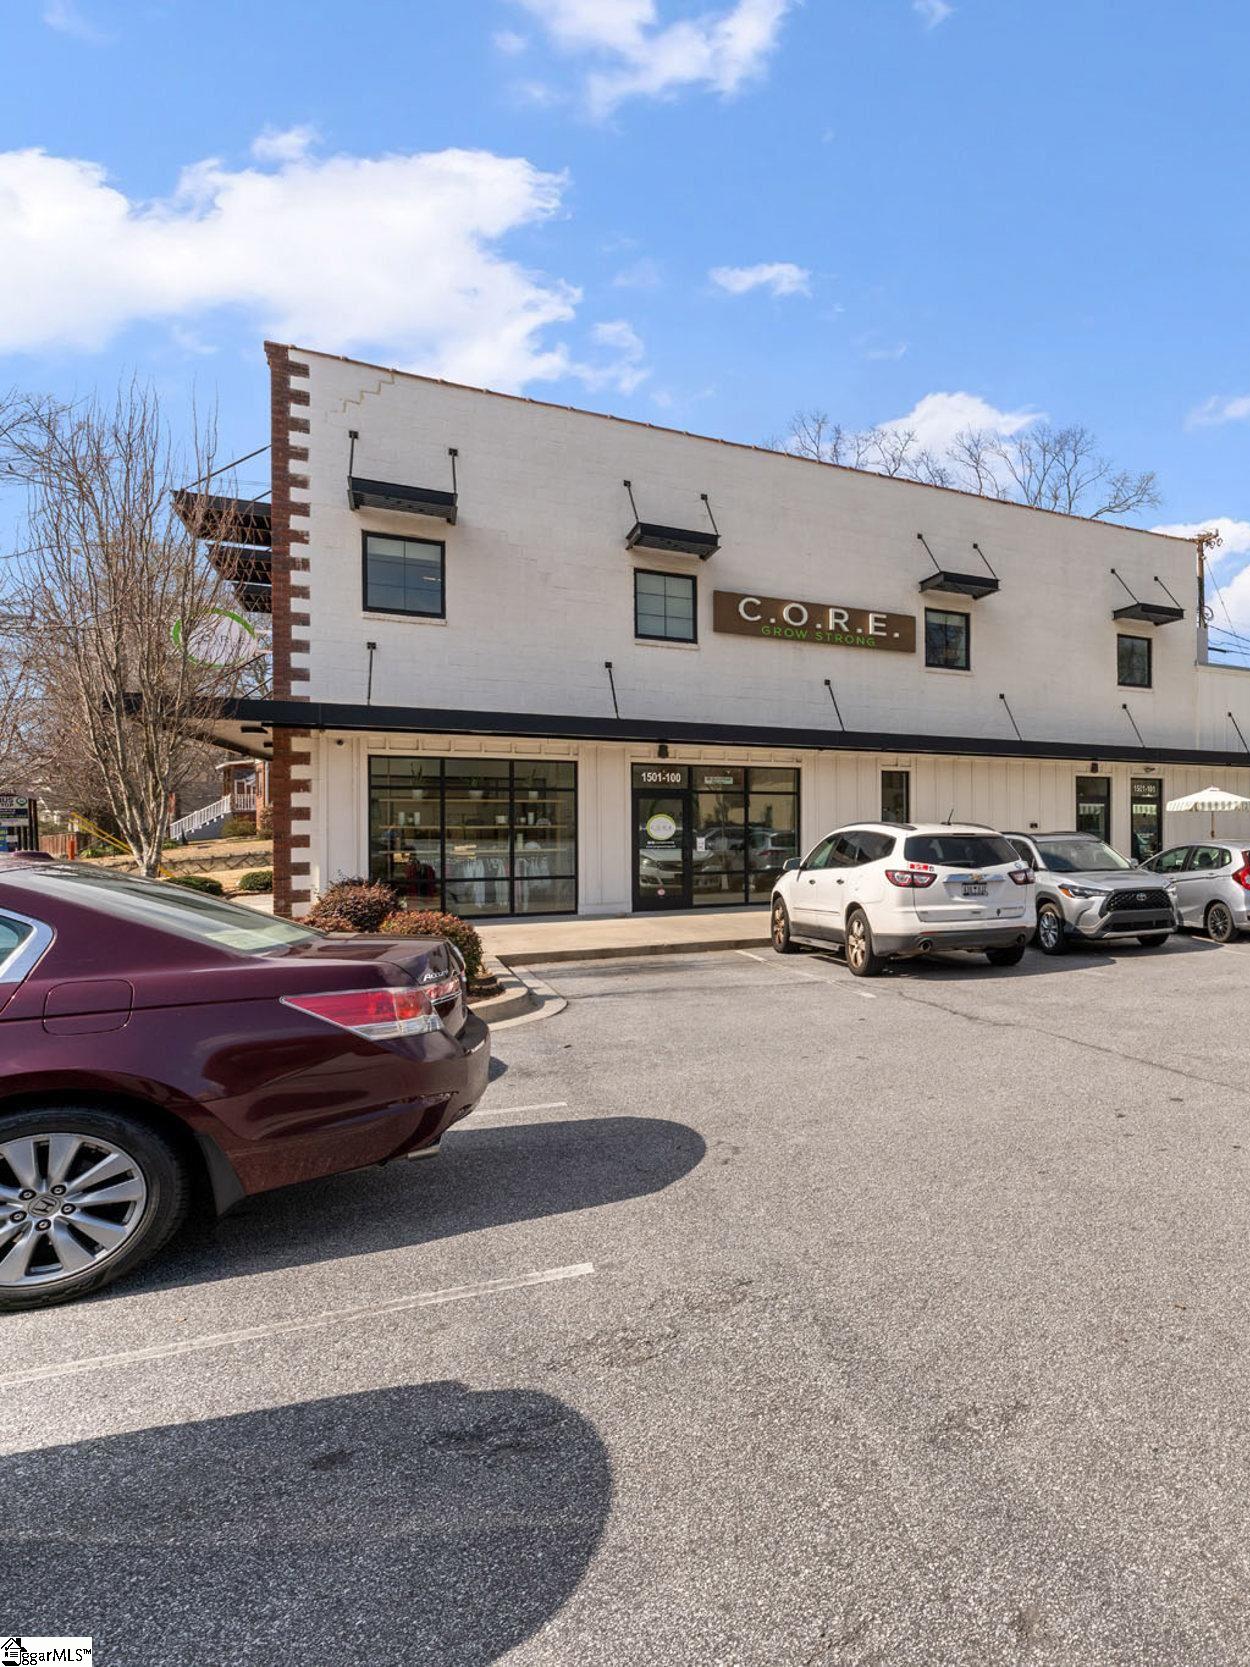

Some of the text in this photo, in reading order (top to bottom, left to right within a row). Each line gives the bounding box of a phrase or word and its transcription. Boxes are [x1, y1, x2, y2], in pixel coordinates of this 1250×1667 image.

[761, 625, 876, 647] GROW STRONG
[641, 771, 681, 783] 1501-100
